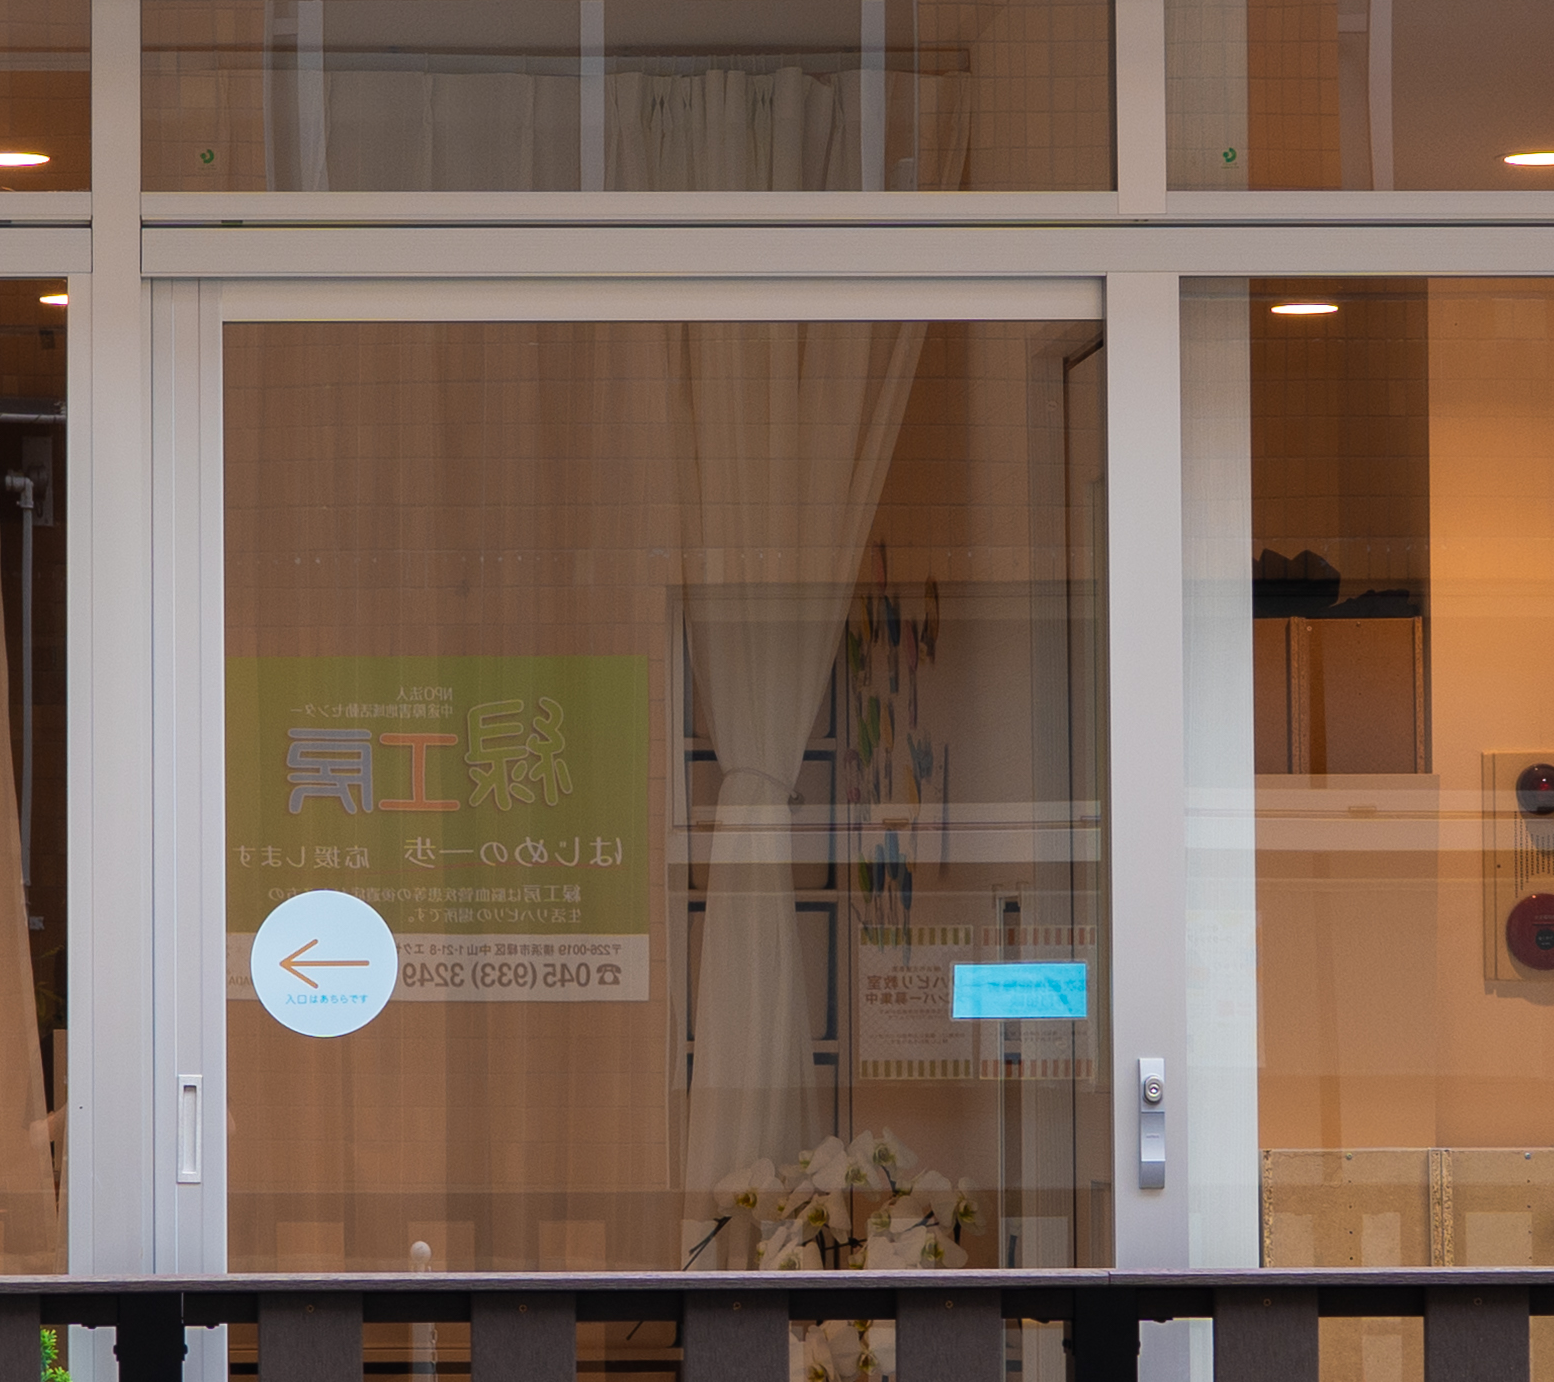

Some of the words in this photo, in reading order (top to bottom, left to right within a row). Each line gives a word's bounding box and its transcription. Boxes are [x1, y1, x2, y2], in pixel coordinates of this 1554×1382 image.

[285, 994, 368, 1005] 入口はあちらです
